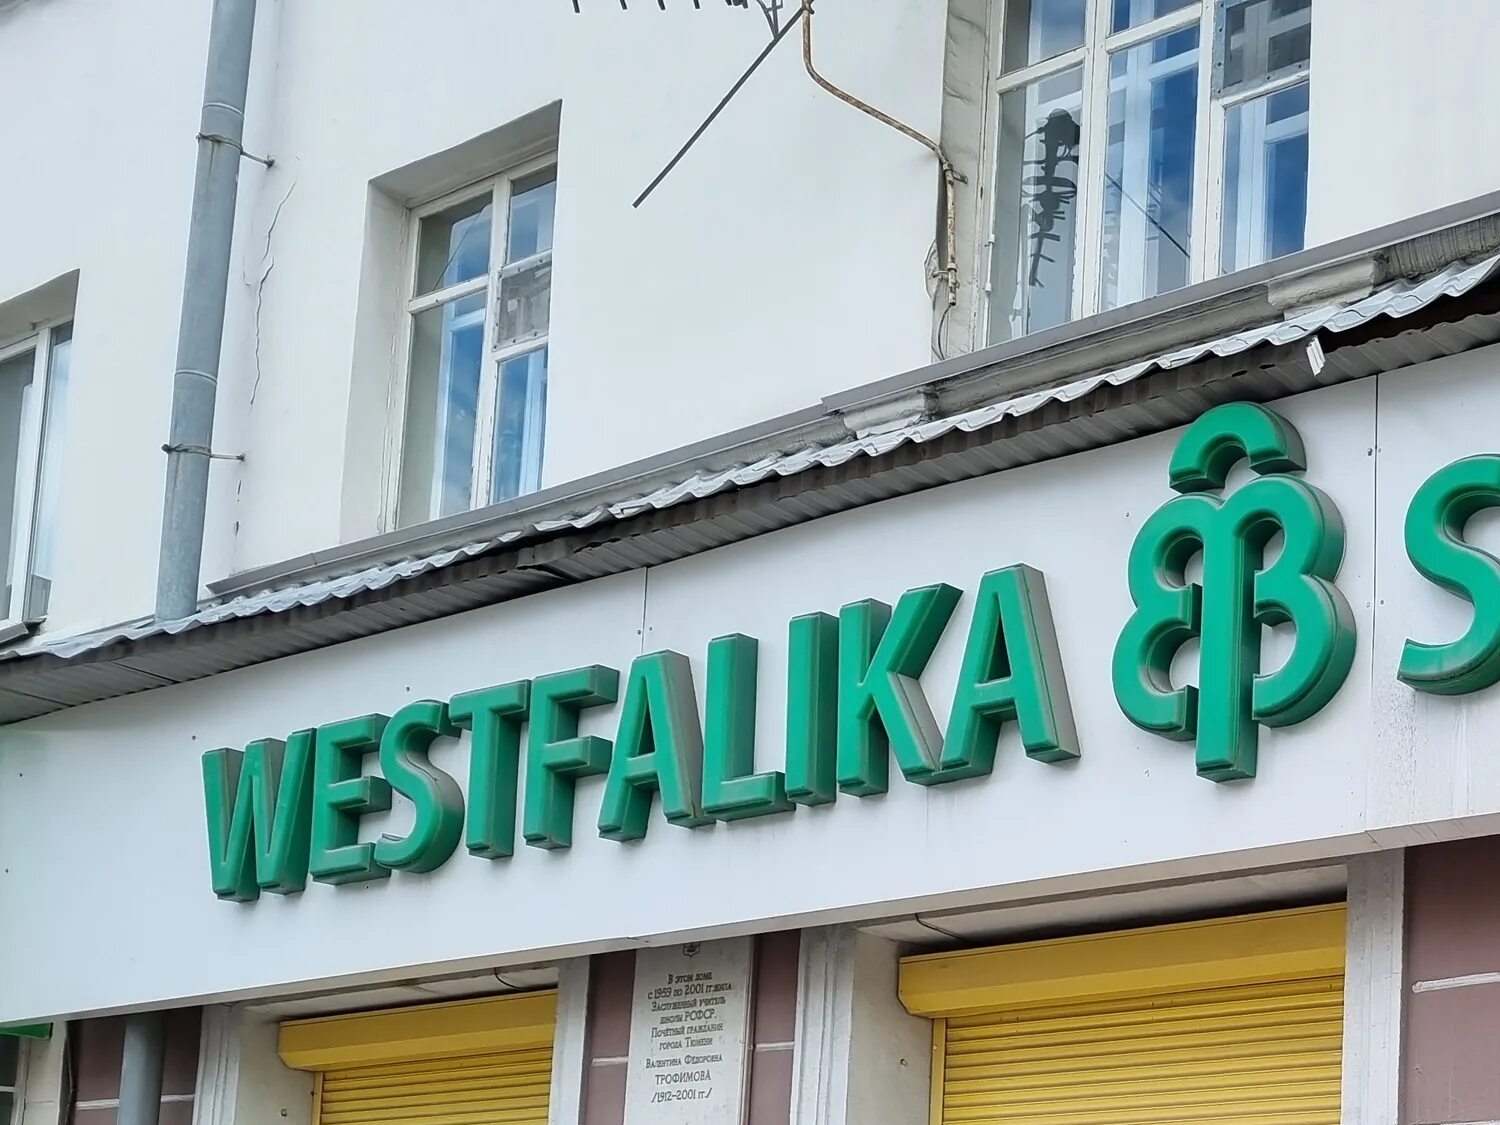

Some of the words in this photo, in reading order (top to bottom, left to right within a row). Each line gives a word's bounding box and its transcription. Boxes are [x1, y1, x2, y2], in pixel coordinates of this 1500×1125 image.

[202, 562, 1080, 903] WESTFALIKA
[668, 974, 674, 984] В
[675, 974, 693, 984] этом
[654, 987, 672, 999] 1959
[673, 989, 683, 997] по
[684, 983, 704, 995] 2001
[659, 1041, 682, 1050] города
[684, 1037, 713, 1048] Тюмени
[645, 1058, 682, 1069] Валентина
[655, 1069, 711, 1085] ТРОФИМОВА
